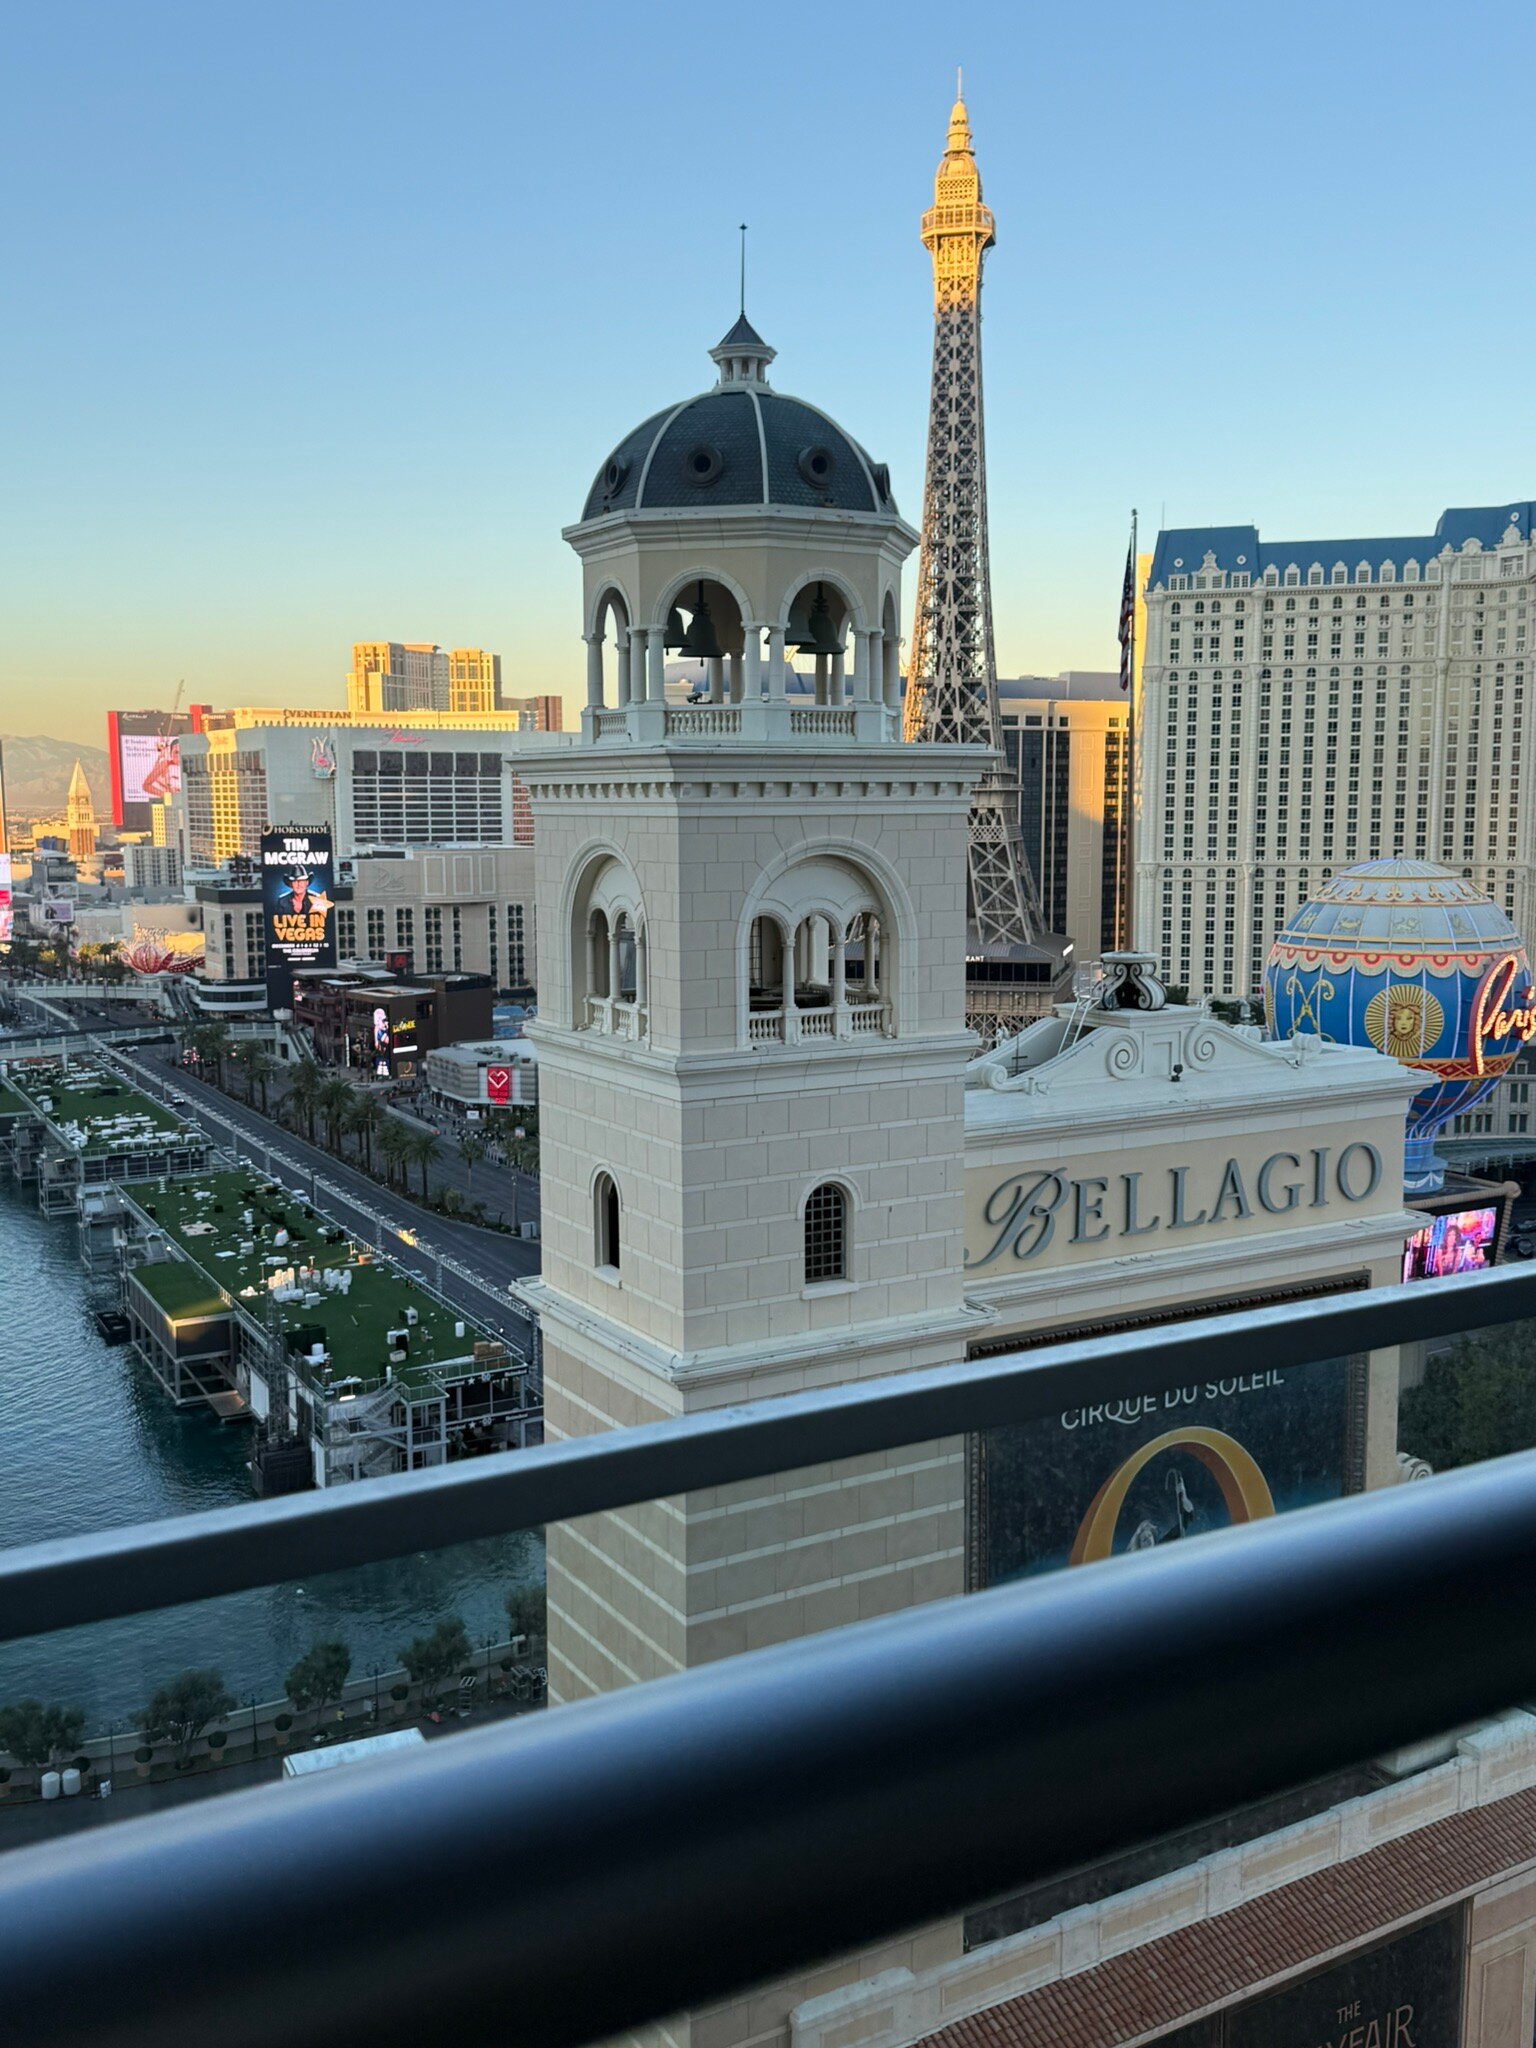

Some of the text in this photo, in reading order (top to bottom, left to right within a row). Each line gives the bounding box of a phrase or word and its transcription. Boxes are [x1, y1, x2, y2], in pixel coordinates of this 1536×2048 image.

[289, 710, 351, 719] VENETIAN
[283, 838, 309, 851] TIM
[264, 852, 329, 865] MCGRAW
[273, 914, 326, 928] LIVE IN
[274, 927, 325, 941] VEGAS
[964, 1141, 1383, 1268] BELLAGIO
[1061, 1369, 1284, 1430] CIRQUE DU SOLEIL
[1336, 2000, 1361, 2024] THE
